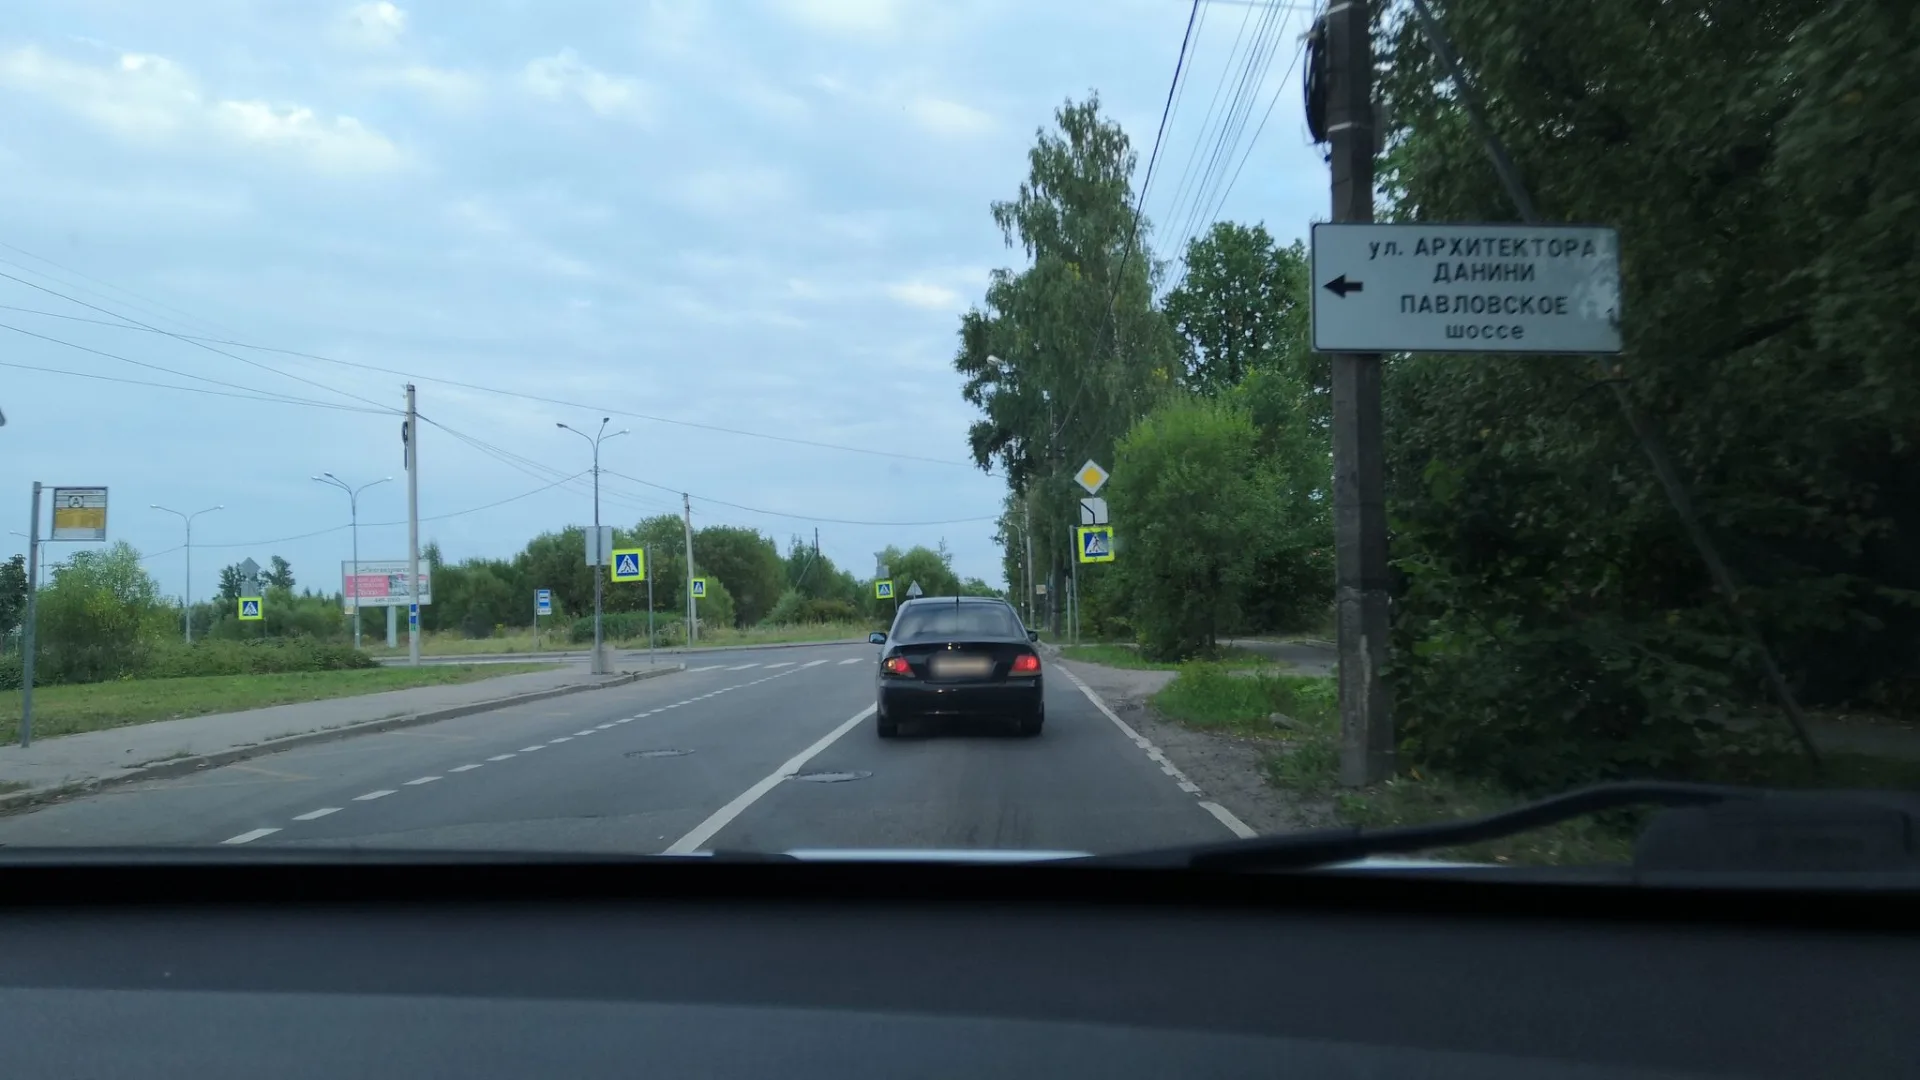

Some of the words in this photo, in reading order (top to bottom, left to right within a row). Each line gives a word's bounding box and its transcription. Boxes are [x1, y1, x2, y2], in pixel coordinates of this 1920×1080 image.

[1369, 241, 1403, 260] ул.
[1413, 237, 1597, 258] АРХИТЕКТОРА
[1433, 263, 1535, 283] ДАНИНИ
[1401, 295, 1568, 315] ПАВЛОВСКОЕ
[1446, 324, 1525, 340] шоссе
